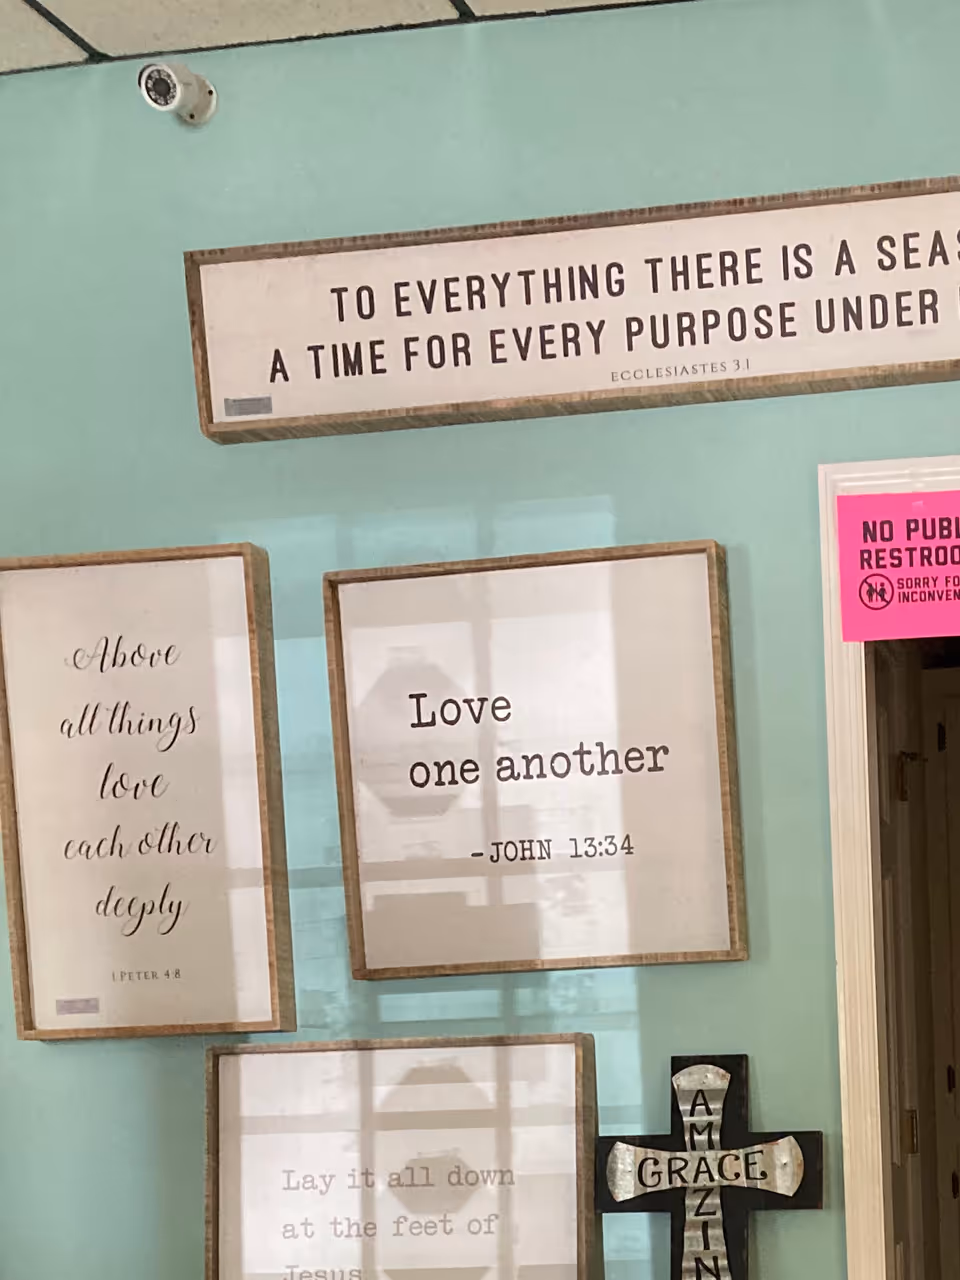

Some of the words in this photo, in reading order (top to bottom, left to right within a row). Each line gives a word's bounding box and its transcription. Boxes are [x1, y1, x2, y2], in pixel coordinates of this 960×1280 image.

[331, 285, 374, 322] TO
[395, 261, 625, 317] EVERYTHING
[645, 247, 763, 293] THERE
[782, 242, 814, 281] IS
[834, 239, 856, 276] A
[269, 348, 289, 383] A
[307, 339, 387, 380] TIME
[404, 332, 471, 372] FOR
[490, 319, 607, 364] EVERY
[625, 301, 797, 352] PURPOSE
[815, 288, 939, 335] UNDER
[611, 361, 727, 382] ECCLESIASTES
[863, 519, 894, 543] NO
[897, 576, 939, 590] SORRY
[65, 634, 181, 673] Above
[60, 702, 101, 739] all
[105, 700, 200, 752] things
[408, 692, 512, 729] Love
[100, 761, 170, 800] love
[409, 758, 480, 788] one
[496, 741, 670, 782] another
[64, 823, 132, 860] each
[138, 821, 217, 855] other
[569, 834, 634, 859] 13:34
[96, 881, 190, 937] deeply
[120, 969, 159, 981] PETER
[281, 1169, 335, 1195] Lay
[347, 1167, 375, 1189] it
[387, 1166, 434, 1188] all
[447, 1165, 515, 1187] down
[637, 1149, 768, 1190] GRACE
[282, 1217, 315, 1239] at
[329, 1216, 377, 1238] the
[392, 1214, 453, 1236] feet
[467, 1213, 500, 1235] of
